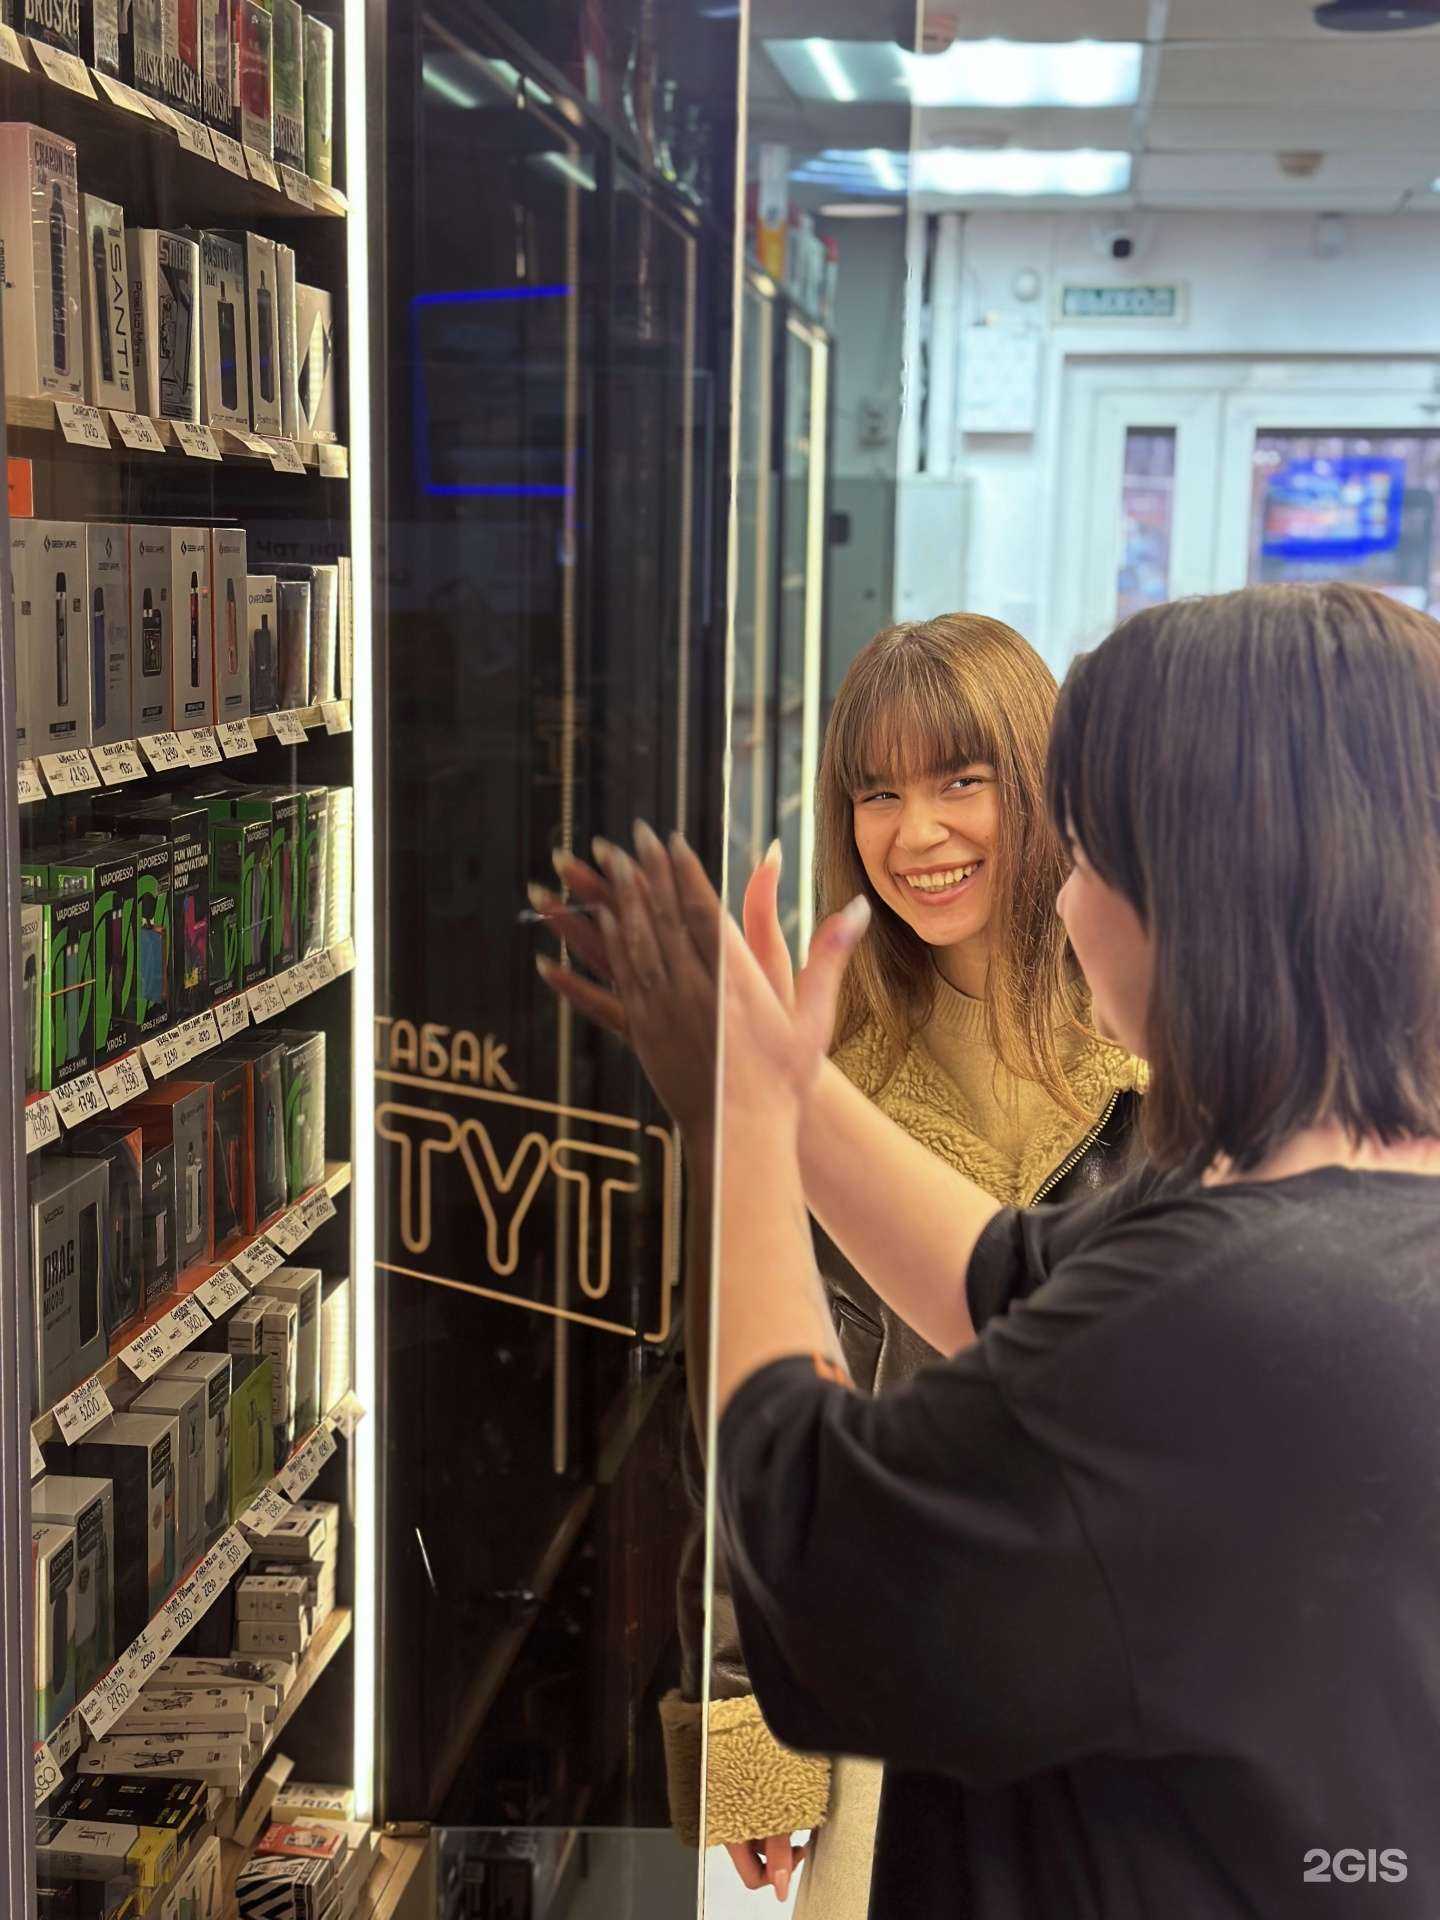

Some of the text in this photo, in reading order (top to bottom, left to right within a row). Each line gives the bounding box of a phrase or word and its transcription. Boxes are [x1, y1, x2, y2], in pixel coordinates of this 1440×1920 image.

[110, 243, 129, 375] SANTI
[137, 851, 169, 872] VAPORESSO
[174, 843, 202, 862] FUN WITH
[174, 854, 208, 876] INNOVATION
[100, 866, 134, 887] VAPORESSO
[174, 874, 189, 890] NOW
[56, 900, 90, 922] VAPORESSO
[106, 1037, 121, 1053] XROS
[374, 1016, 518, 1092] ТАБАК
[54, 1083, 74, 1100] XROS
[78, 1090, 98, 1112] 1790
[375, 1102, 641, 1300] ТУТ
[43, 1239, 74, 1295] DRAG
[79, 1396, 100, 1422] 5200
[174, 1606, 193, 1629] 2250
[106, 1682, 130, 1712] 2750
